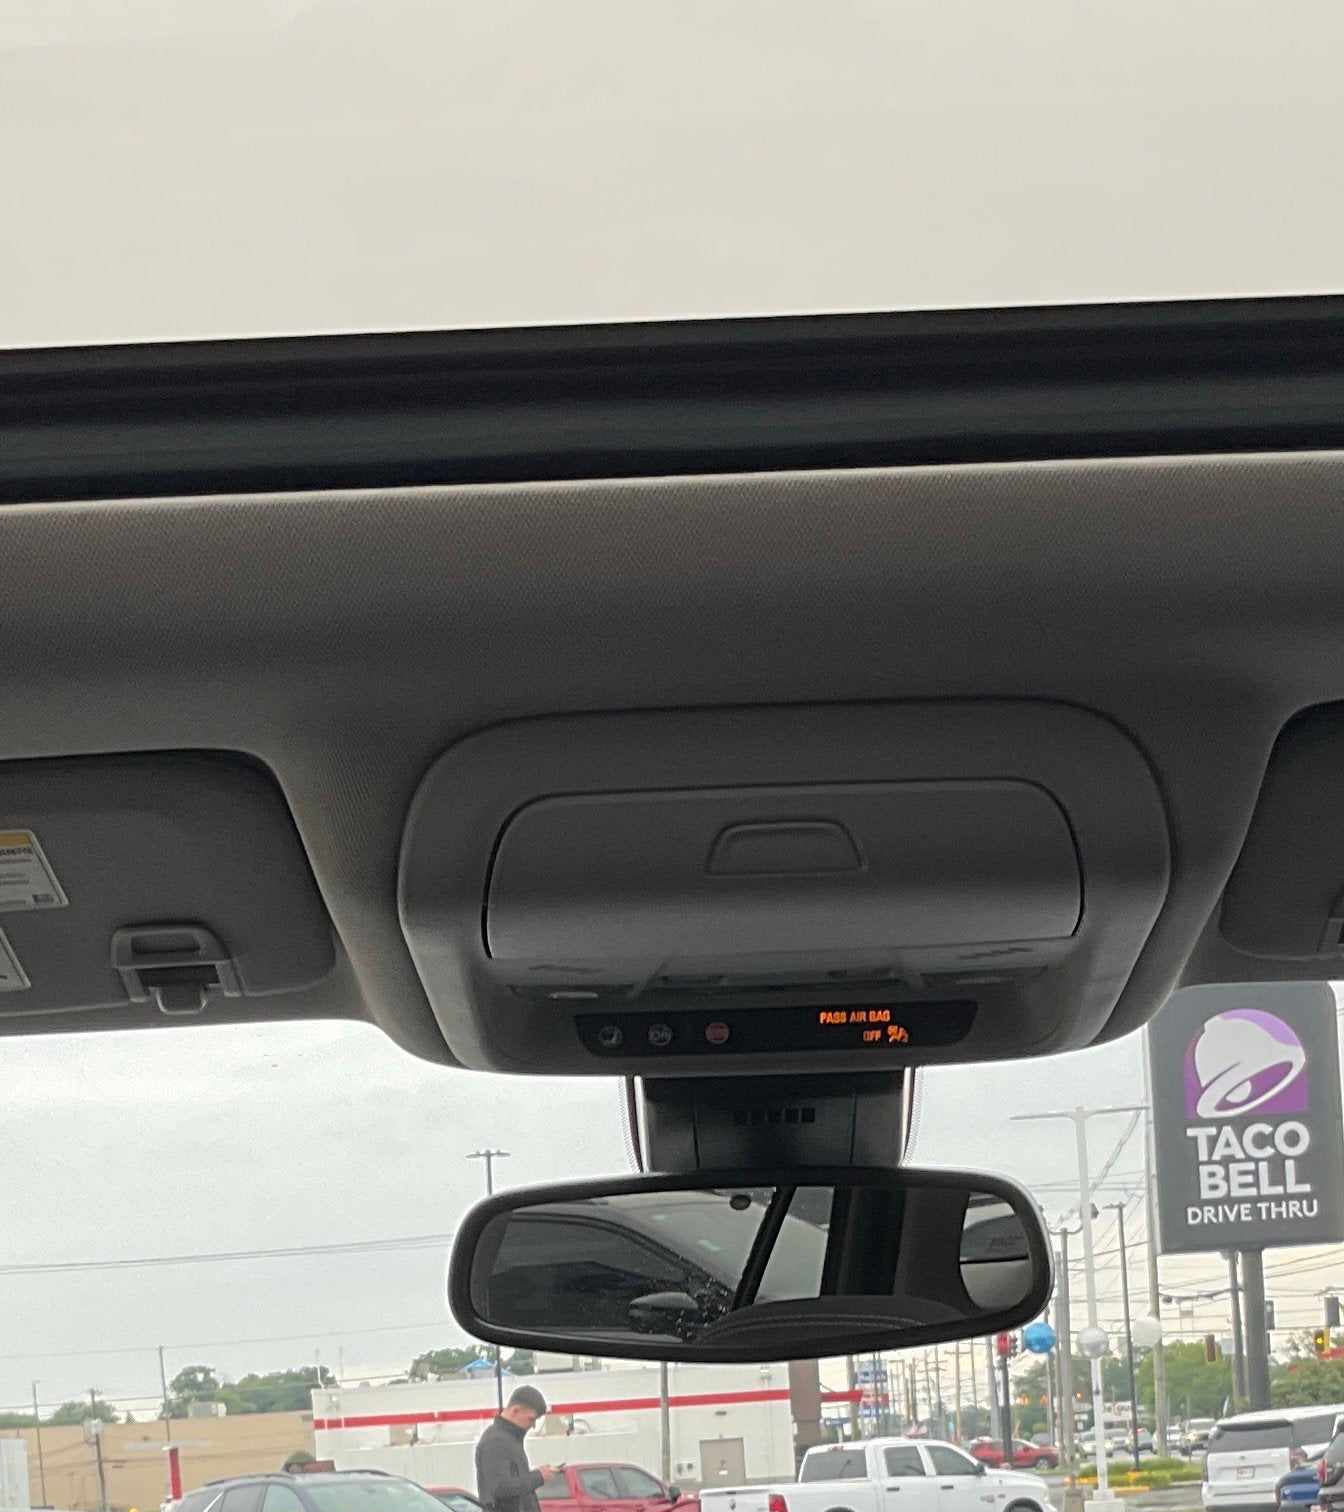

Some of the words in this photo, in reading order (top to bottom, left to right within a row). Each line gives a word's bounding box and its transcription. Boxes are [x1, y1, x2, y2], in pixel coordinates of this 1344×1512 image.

[849, 1011, 867, 1023] AIR
[863, 1030, 882, 1041] OFF
[1186, 1121, 1310, 1162] TACO
[1198, 1160, 1312, 1200] BELL
[1186, 1201, 1253, 1226] DRIVE
[1257, 1198, 1319, 1223] THRU
